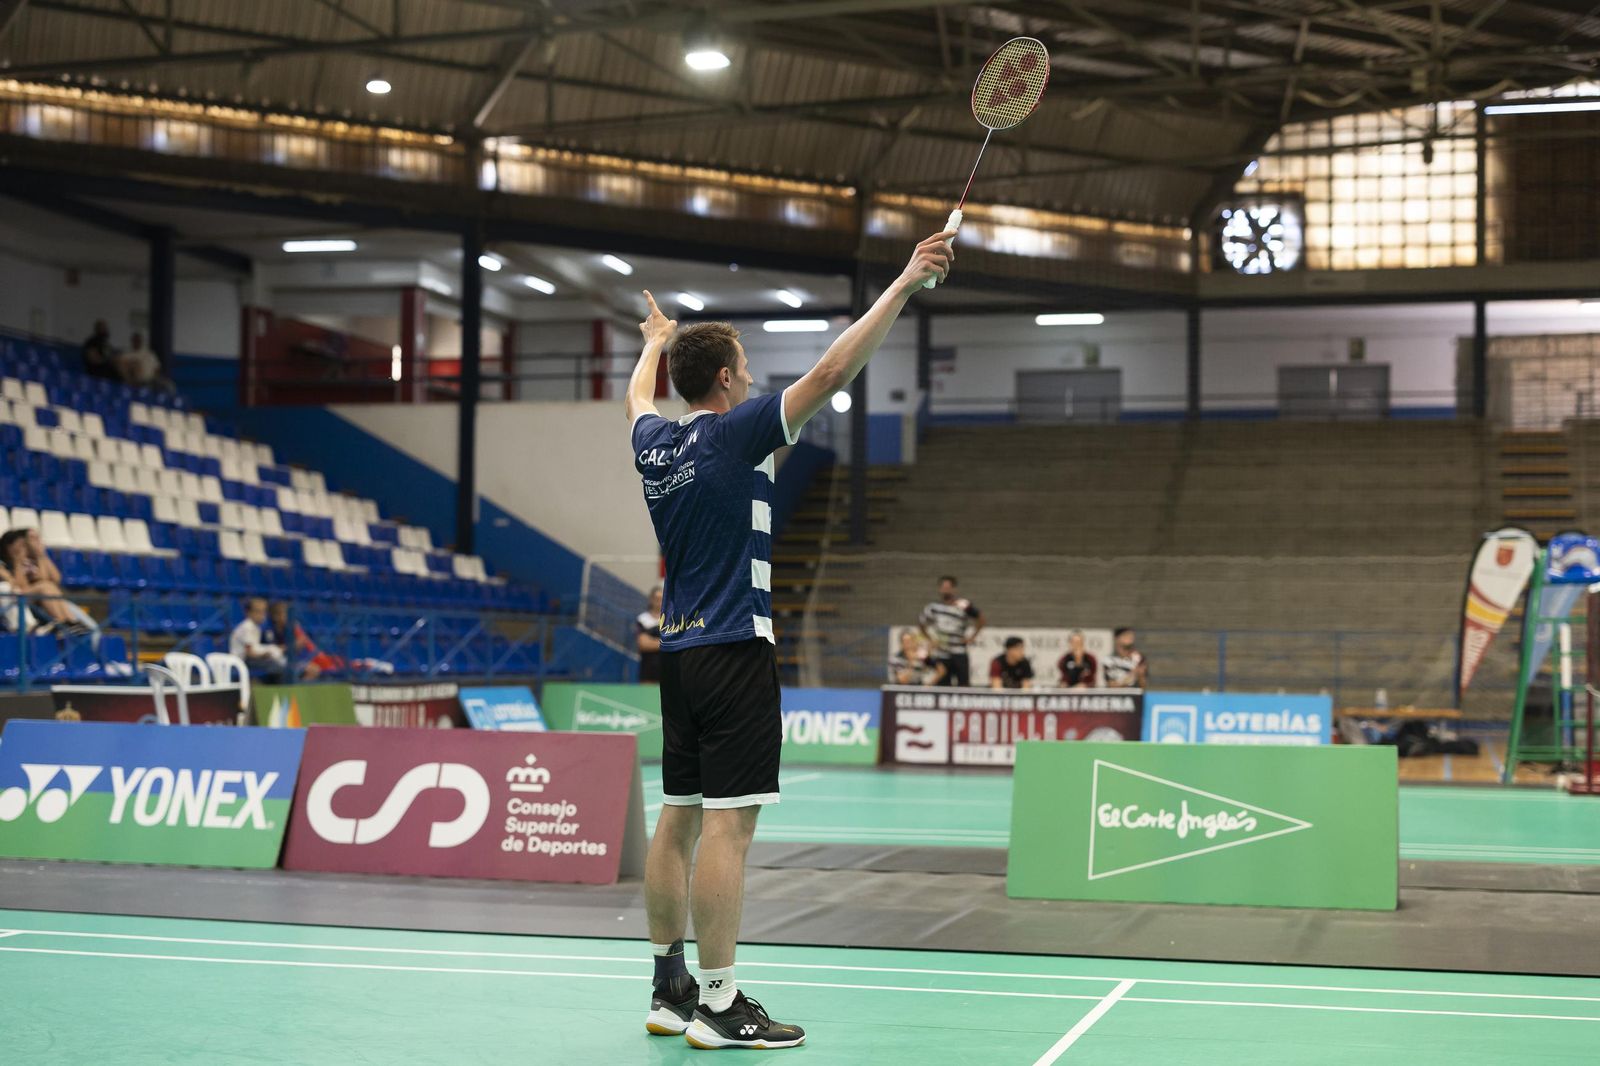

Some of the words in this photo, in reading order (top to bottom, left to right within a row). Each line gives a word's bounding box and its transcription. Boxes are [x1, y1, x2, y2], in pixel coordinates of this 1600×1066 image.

[781, 710, 871, 746] YONEX
[1204, 709, 1322, 733] LOTERÍAS
[109, 766, 280, 830] YONEX
[507, 798, 577, 823] Consejo
[505, 816, 580, 836] Superior
[1098, 803, 1121, 827] El
[1122, 805, 1176, 828] Corte
[1177, 800, 1257, 838] Inglés
[501, 835, 524, 852] de
[527, 836, 607, 857] Deportes
